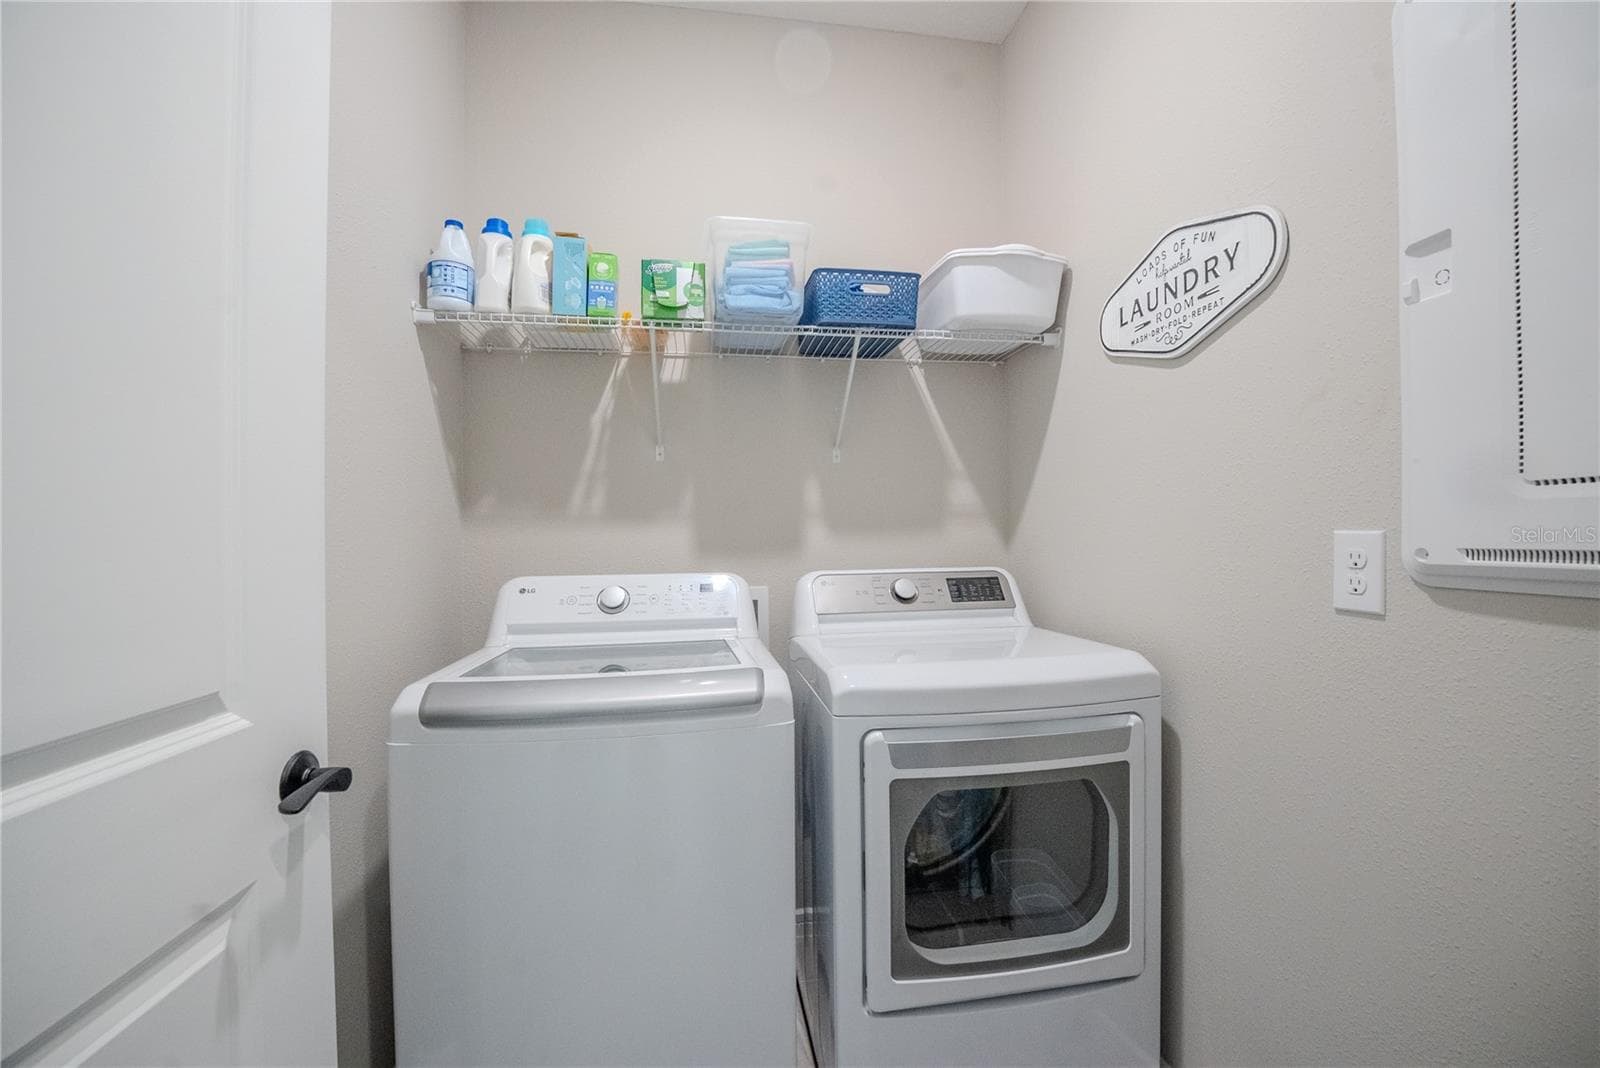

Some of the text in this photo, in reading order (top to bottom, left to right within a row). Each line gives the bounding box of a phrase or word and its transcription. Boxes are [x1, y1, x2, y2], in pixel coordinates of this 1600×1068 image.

[1119, 240, 1241, 328] LAUNDRY
[1135, 231, 1216, 285] LOADS OF FUN
[1156, 295, 1194, 324] ROOM
